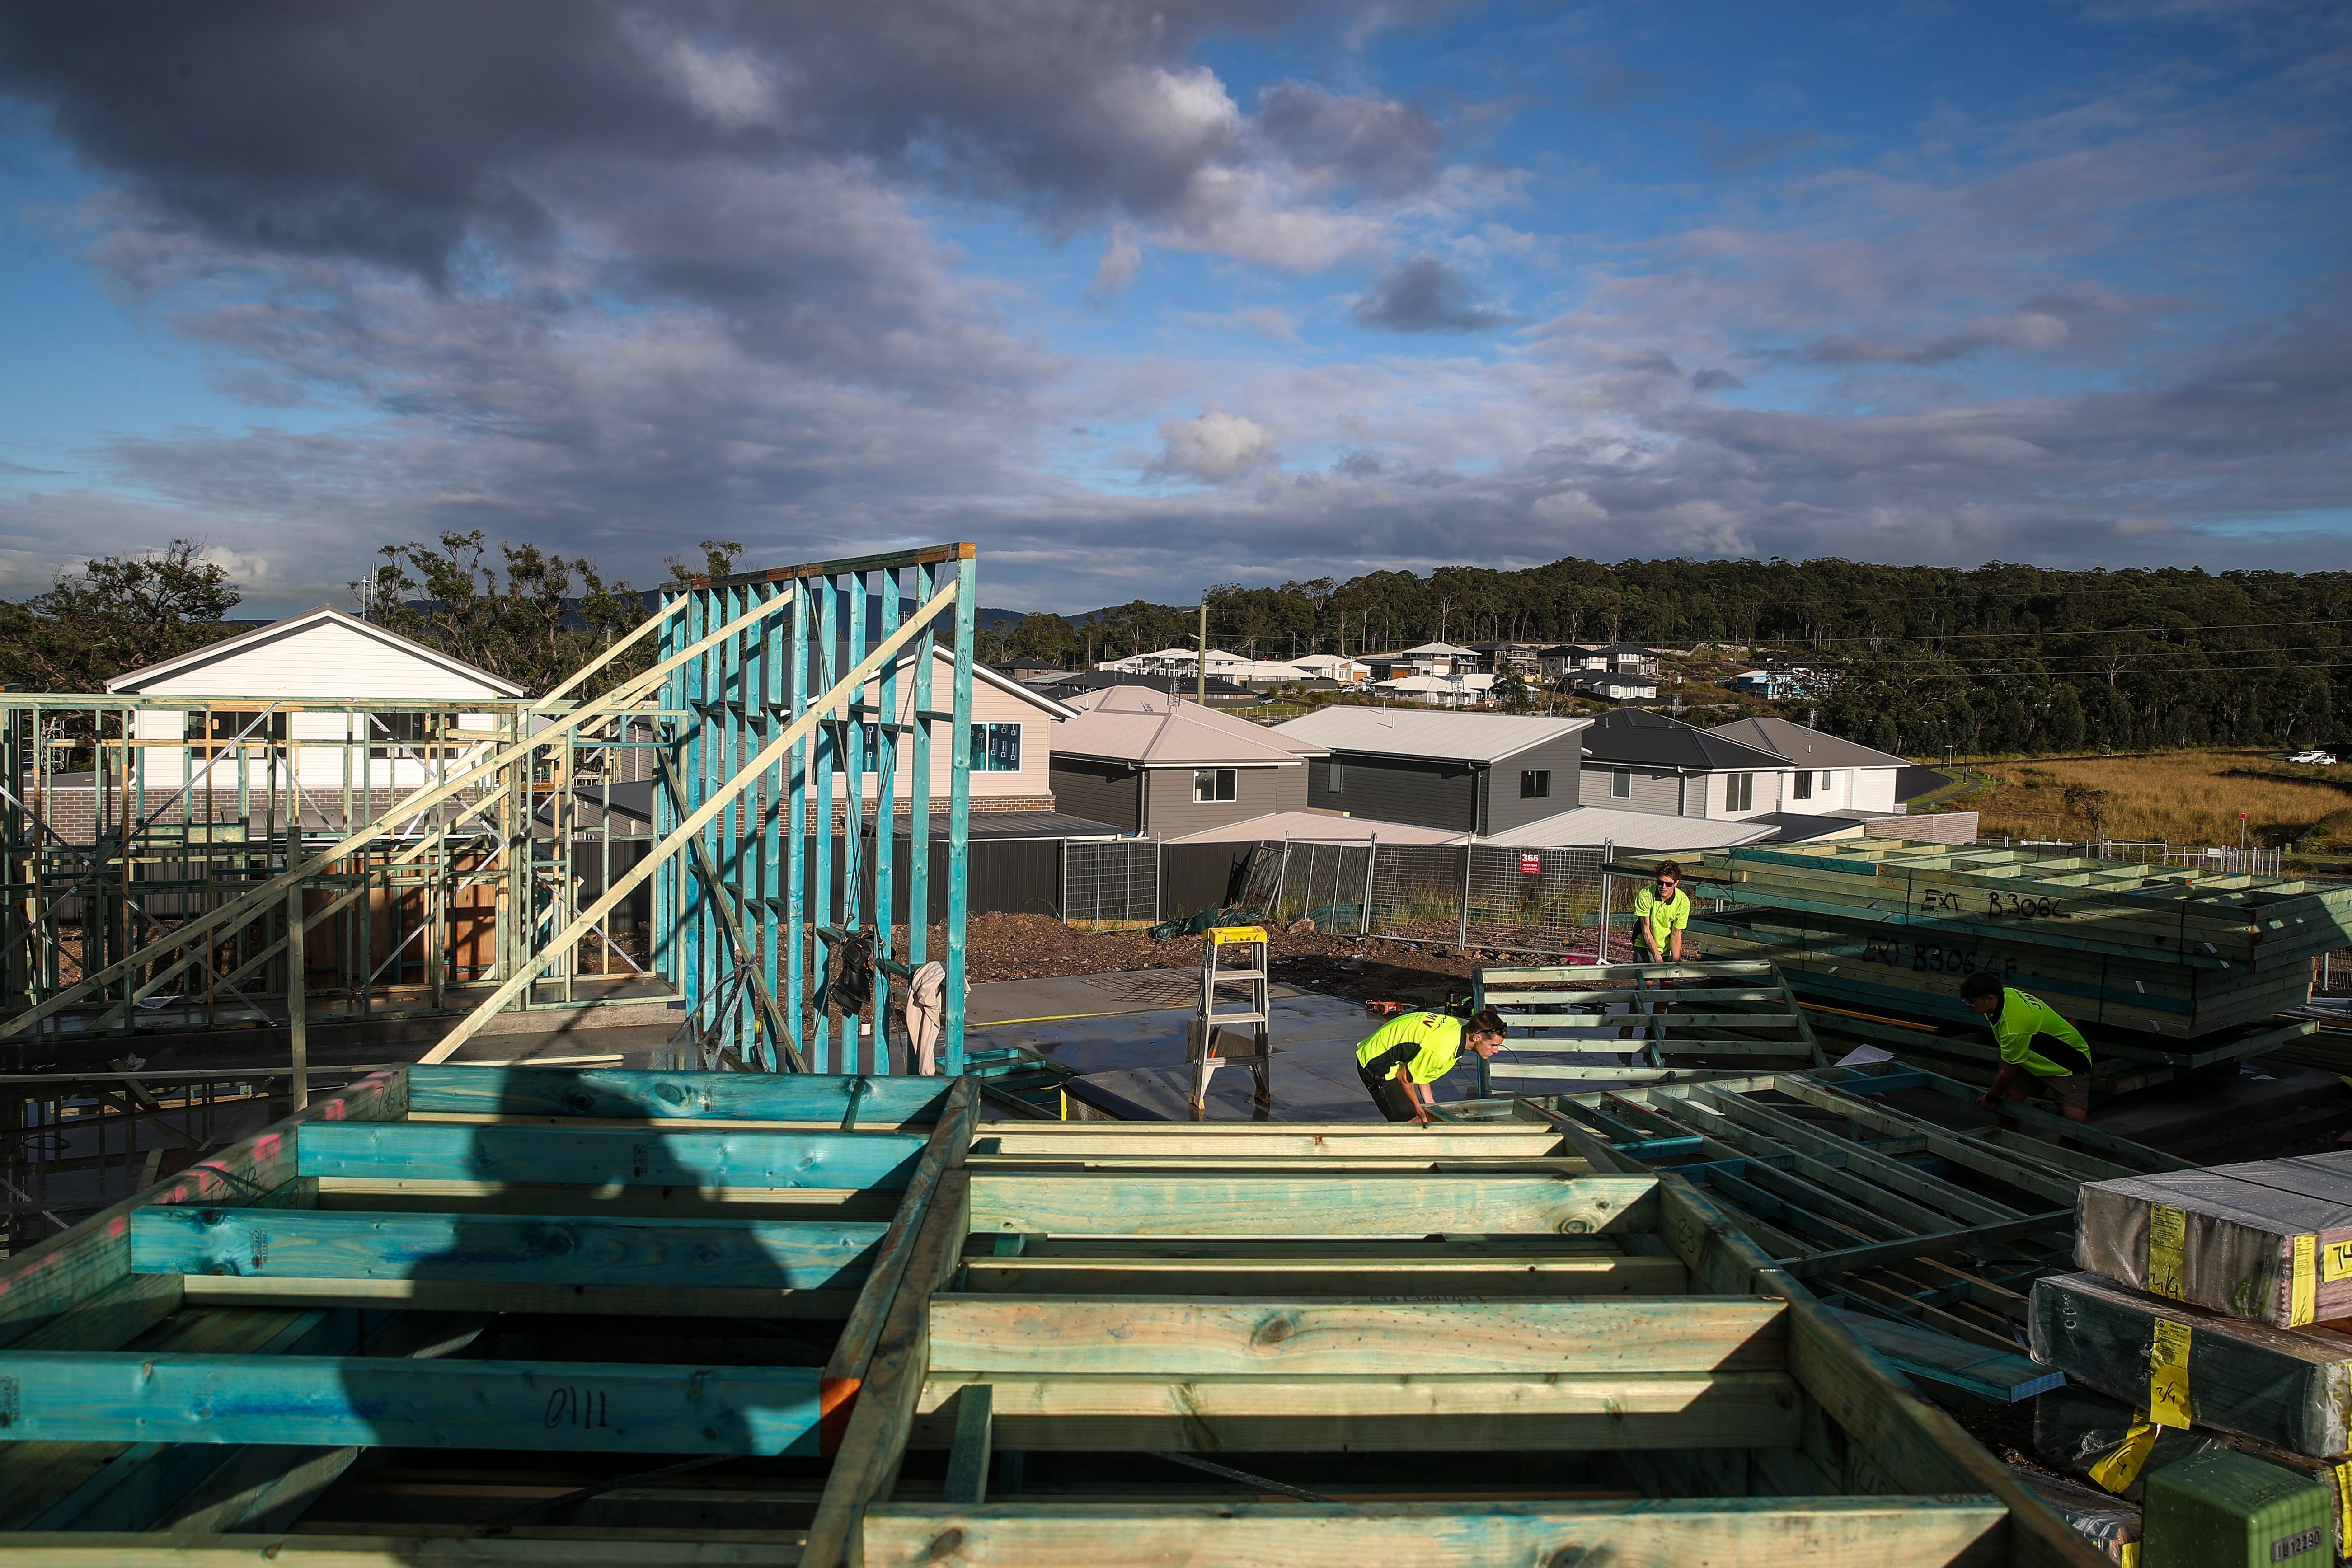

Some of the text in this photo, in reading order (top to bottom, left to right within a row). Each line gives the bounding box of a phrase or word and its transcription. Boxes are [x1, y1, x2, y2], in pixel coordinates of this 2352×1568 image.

[1224, 934, 1258, 942] BAILEY
[1677, 1218, 1695, 1253] 83
[2155, 1381, 2176, 1405] 3/4
